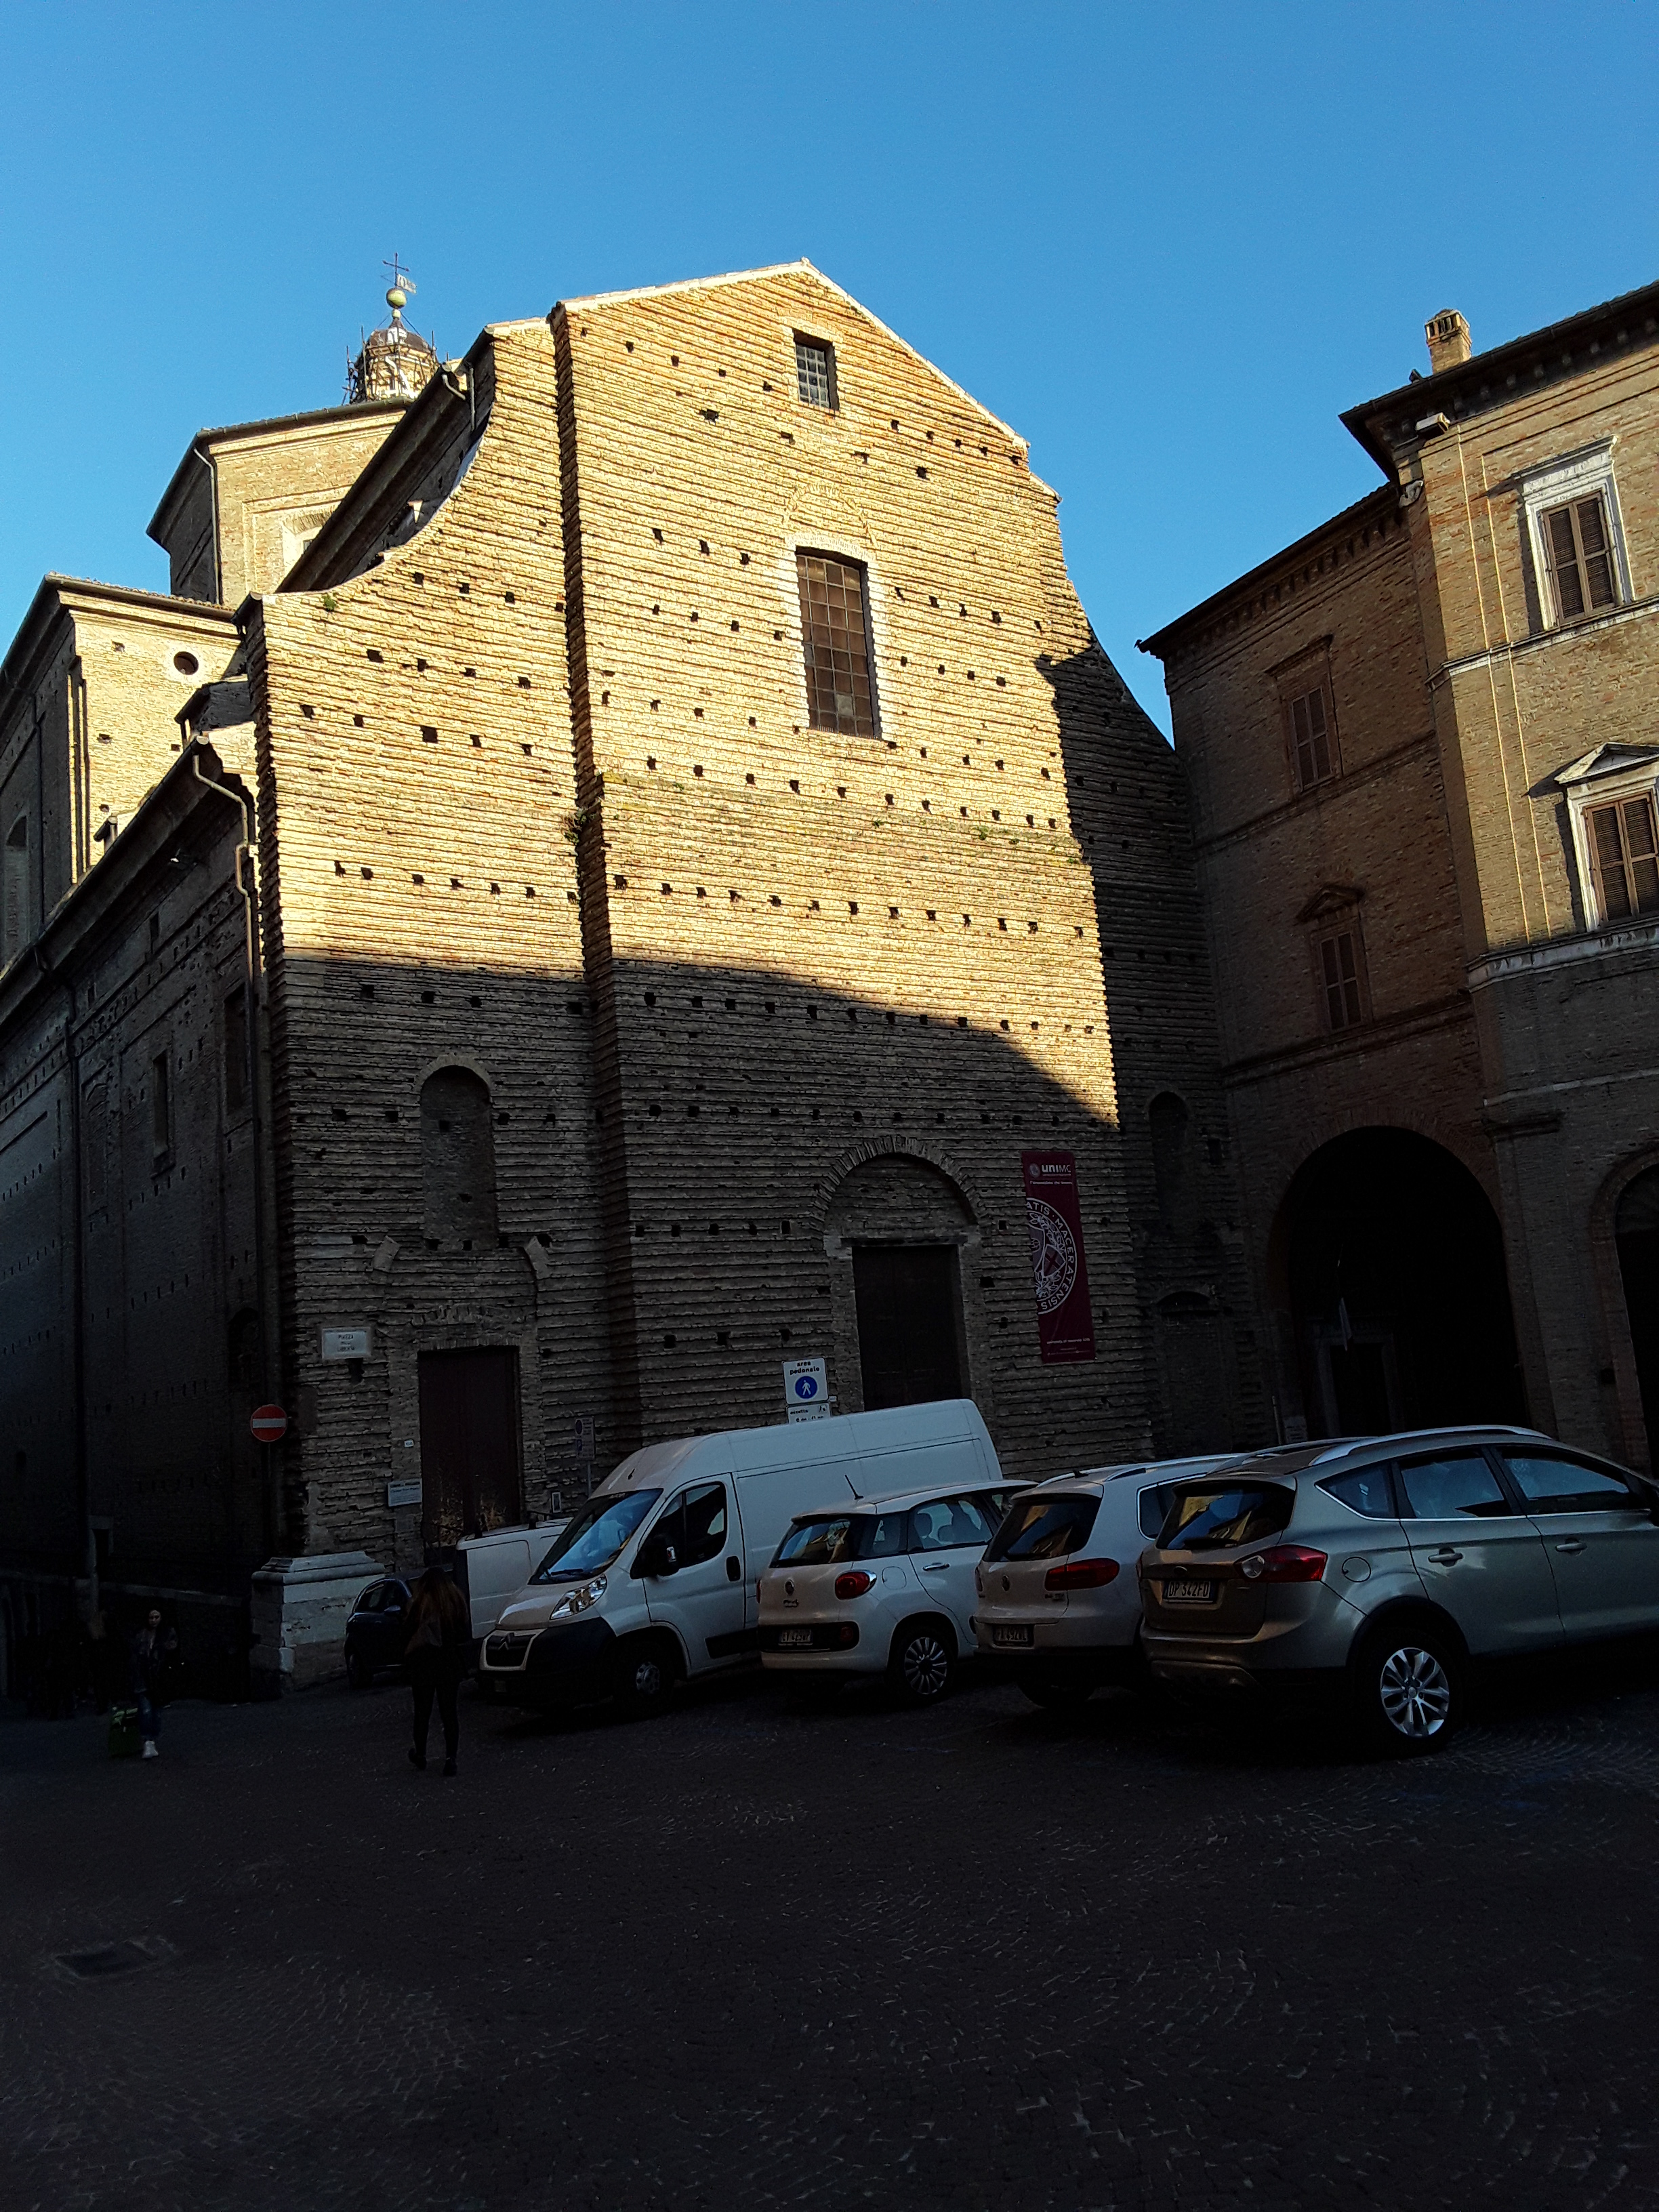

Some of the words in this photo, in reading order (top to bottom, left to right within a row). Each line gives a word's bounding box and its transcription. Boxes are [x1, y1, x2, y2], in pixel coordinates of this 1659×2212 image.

[1040, 1218, 1075, 1311] MACERATENSIS
[790, 1366, 820, 1375] pedonale
[1169, 1582, 1180, 1597] DP
